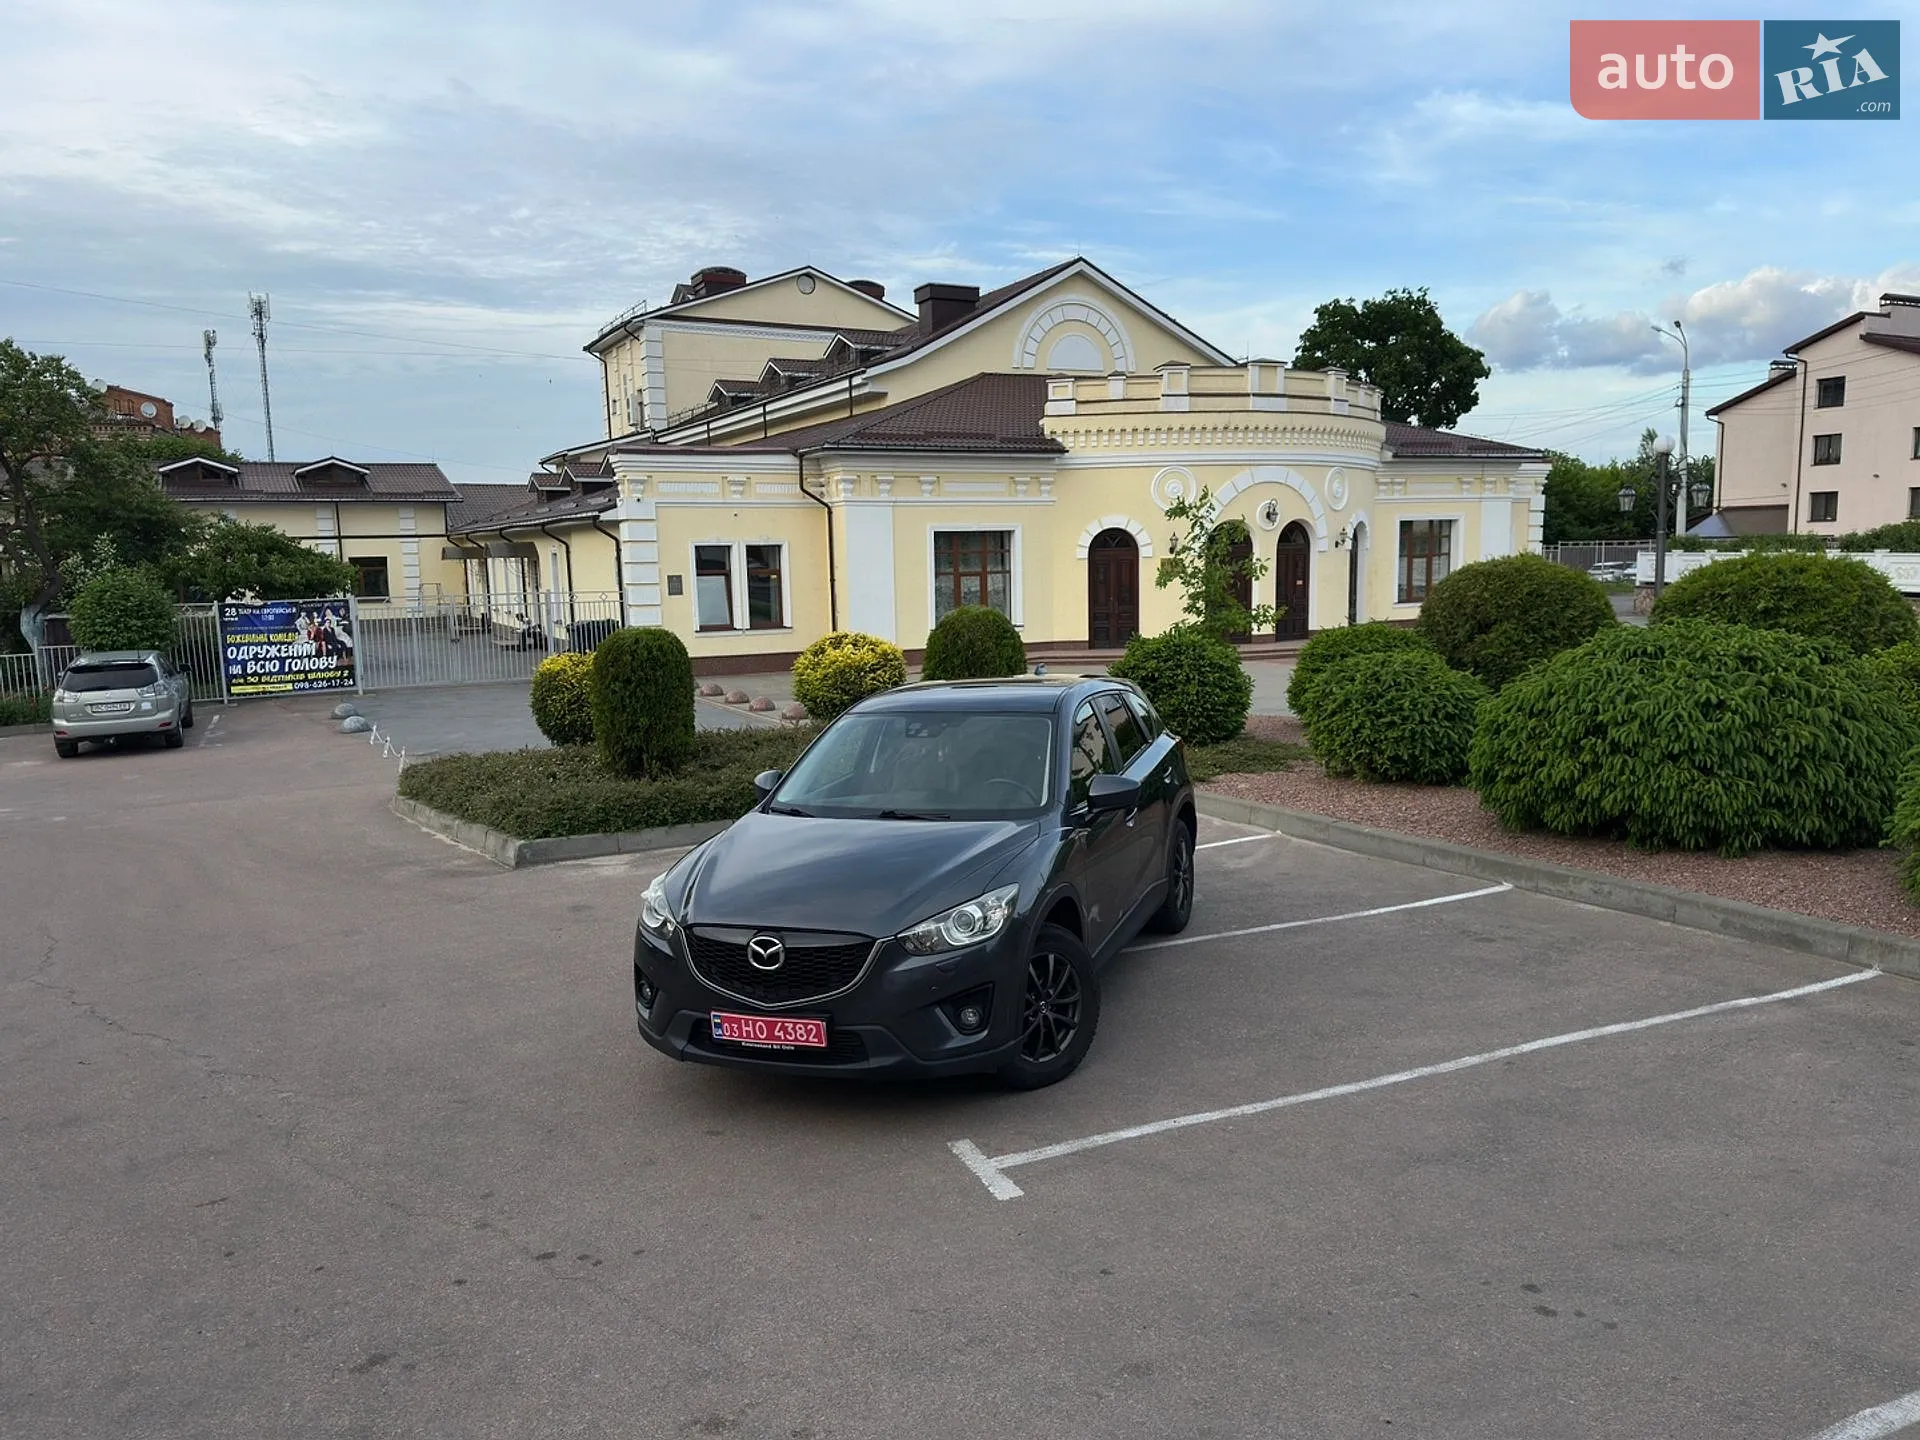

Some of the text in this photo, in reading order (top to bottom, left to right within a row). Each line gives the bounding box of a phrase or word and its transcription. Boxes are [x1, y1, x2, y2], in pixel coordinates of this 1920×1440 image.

[224, 607, 237, 616] 28
[226, 643, 316, 661] ОДРУЖЕНИЙ
[246, 660, 279, 674] ВСЮ
[284, 655, 338, 672] ГОЛОВУ
[774, 1022, 819, 1043] 4382
